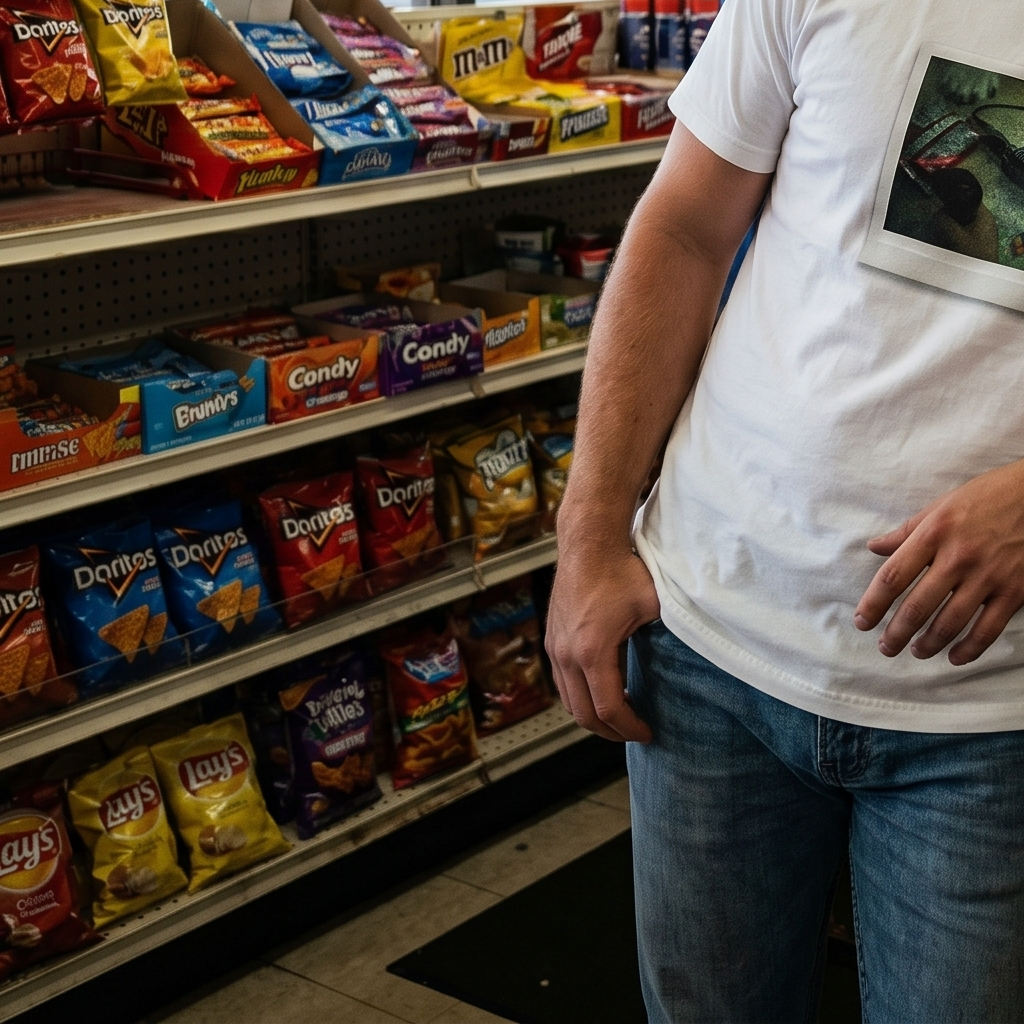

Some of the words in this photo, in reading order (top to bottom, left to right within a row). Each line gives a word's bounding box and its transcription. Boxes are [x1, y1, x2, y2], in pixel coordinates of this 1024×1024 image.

[283, 503, 354, 539] Doritos
[74, 547, 156, 589] Doritos
[171, 527, 248, 568] Doritos
[186, 744, 244, 791] Lay's
